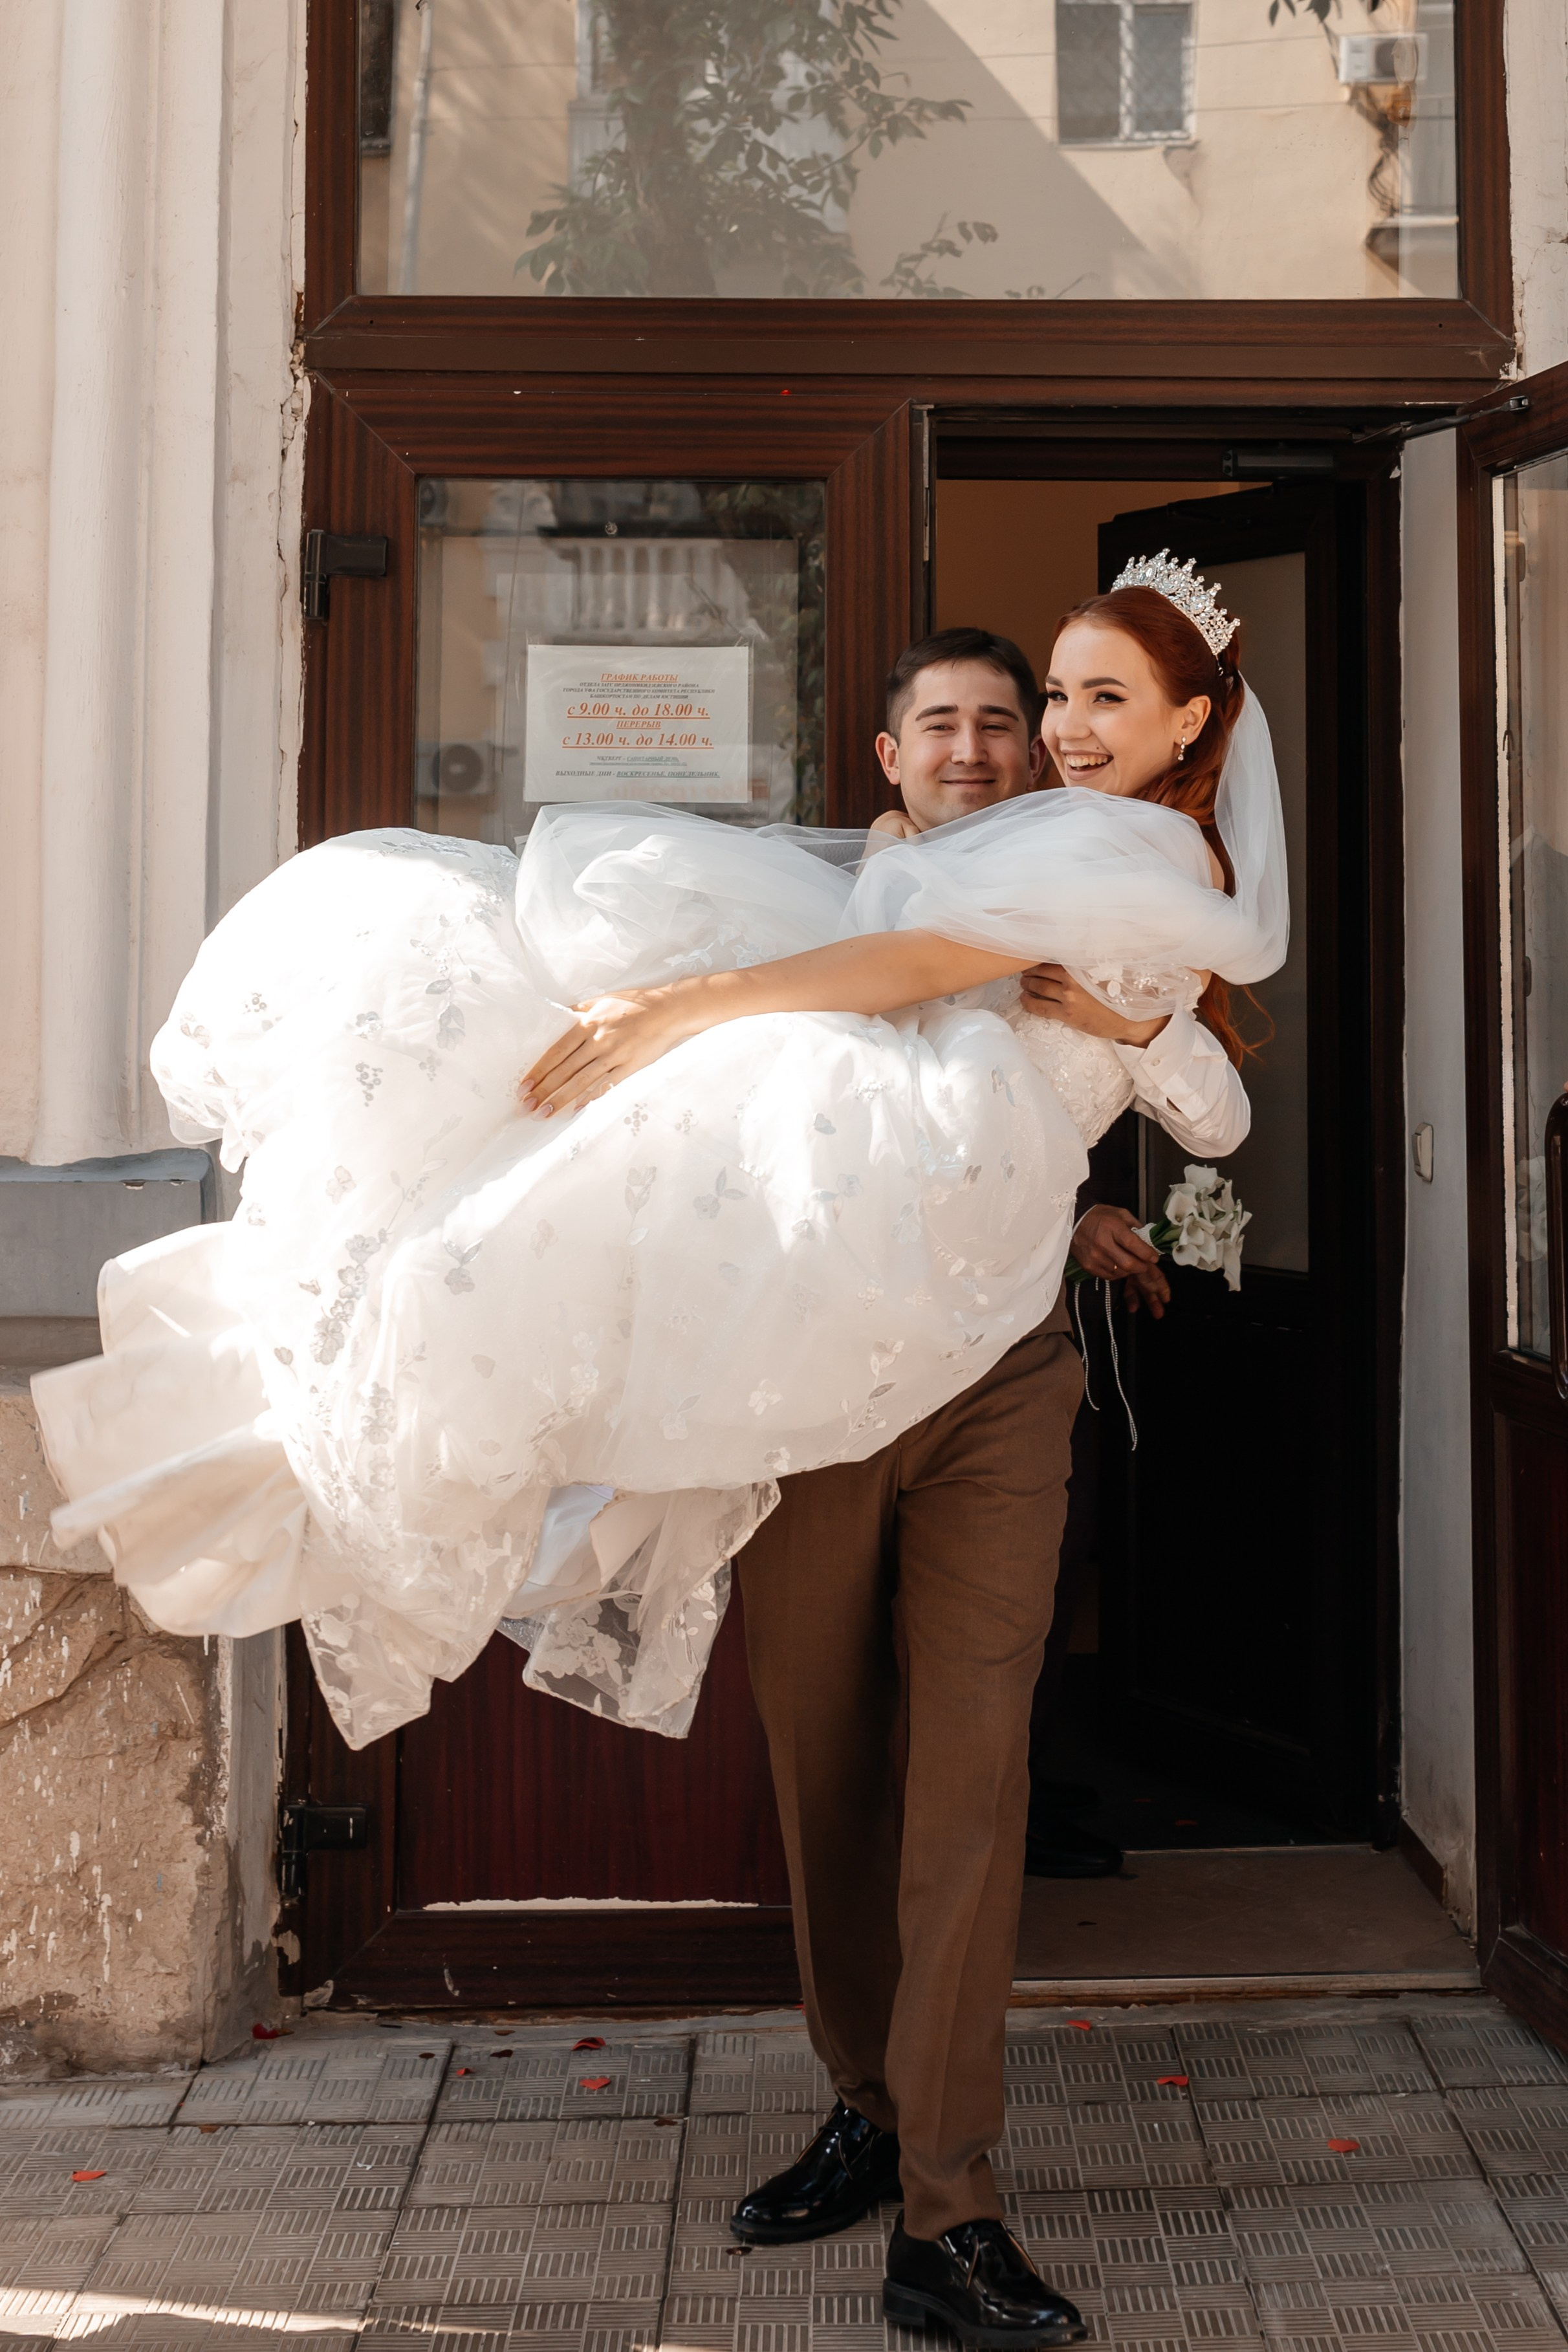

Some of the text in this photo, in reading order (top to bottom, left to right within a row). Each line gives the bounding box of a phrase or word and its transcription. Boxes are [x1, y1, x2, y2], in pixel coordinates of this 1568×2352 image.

[567, 702, 708, 716] с 9.00 ч. до 18.00 ч.
[562, 733, 712, 746] с 13.00 ч. до 14.00 ч.
